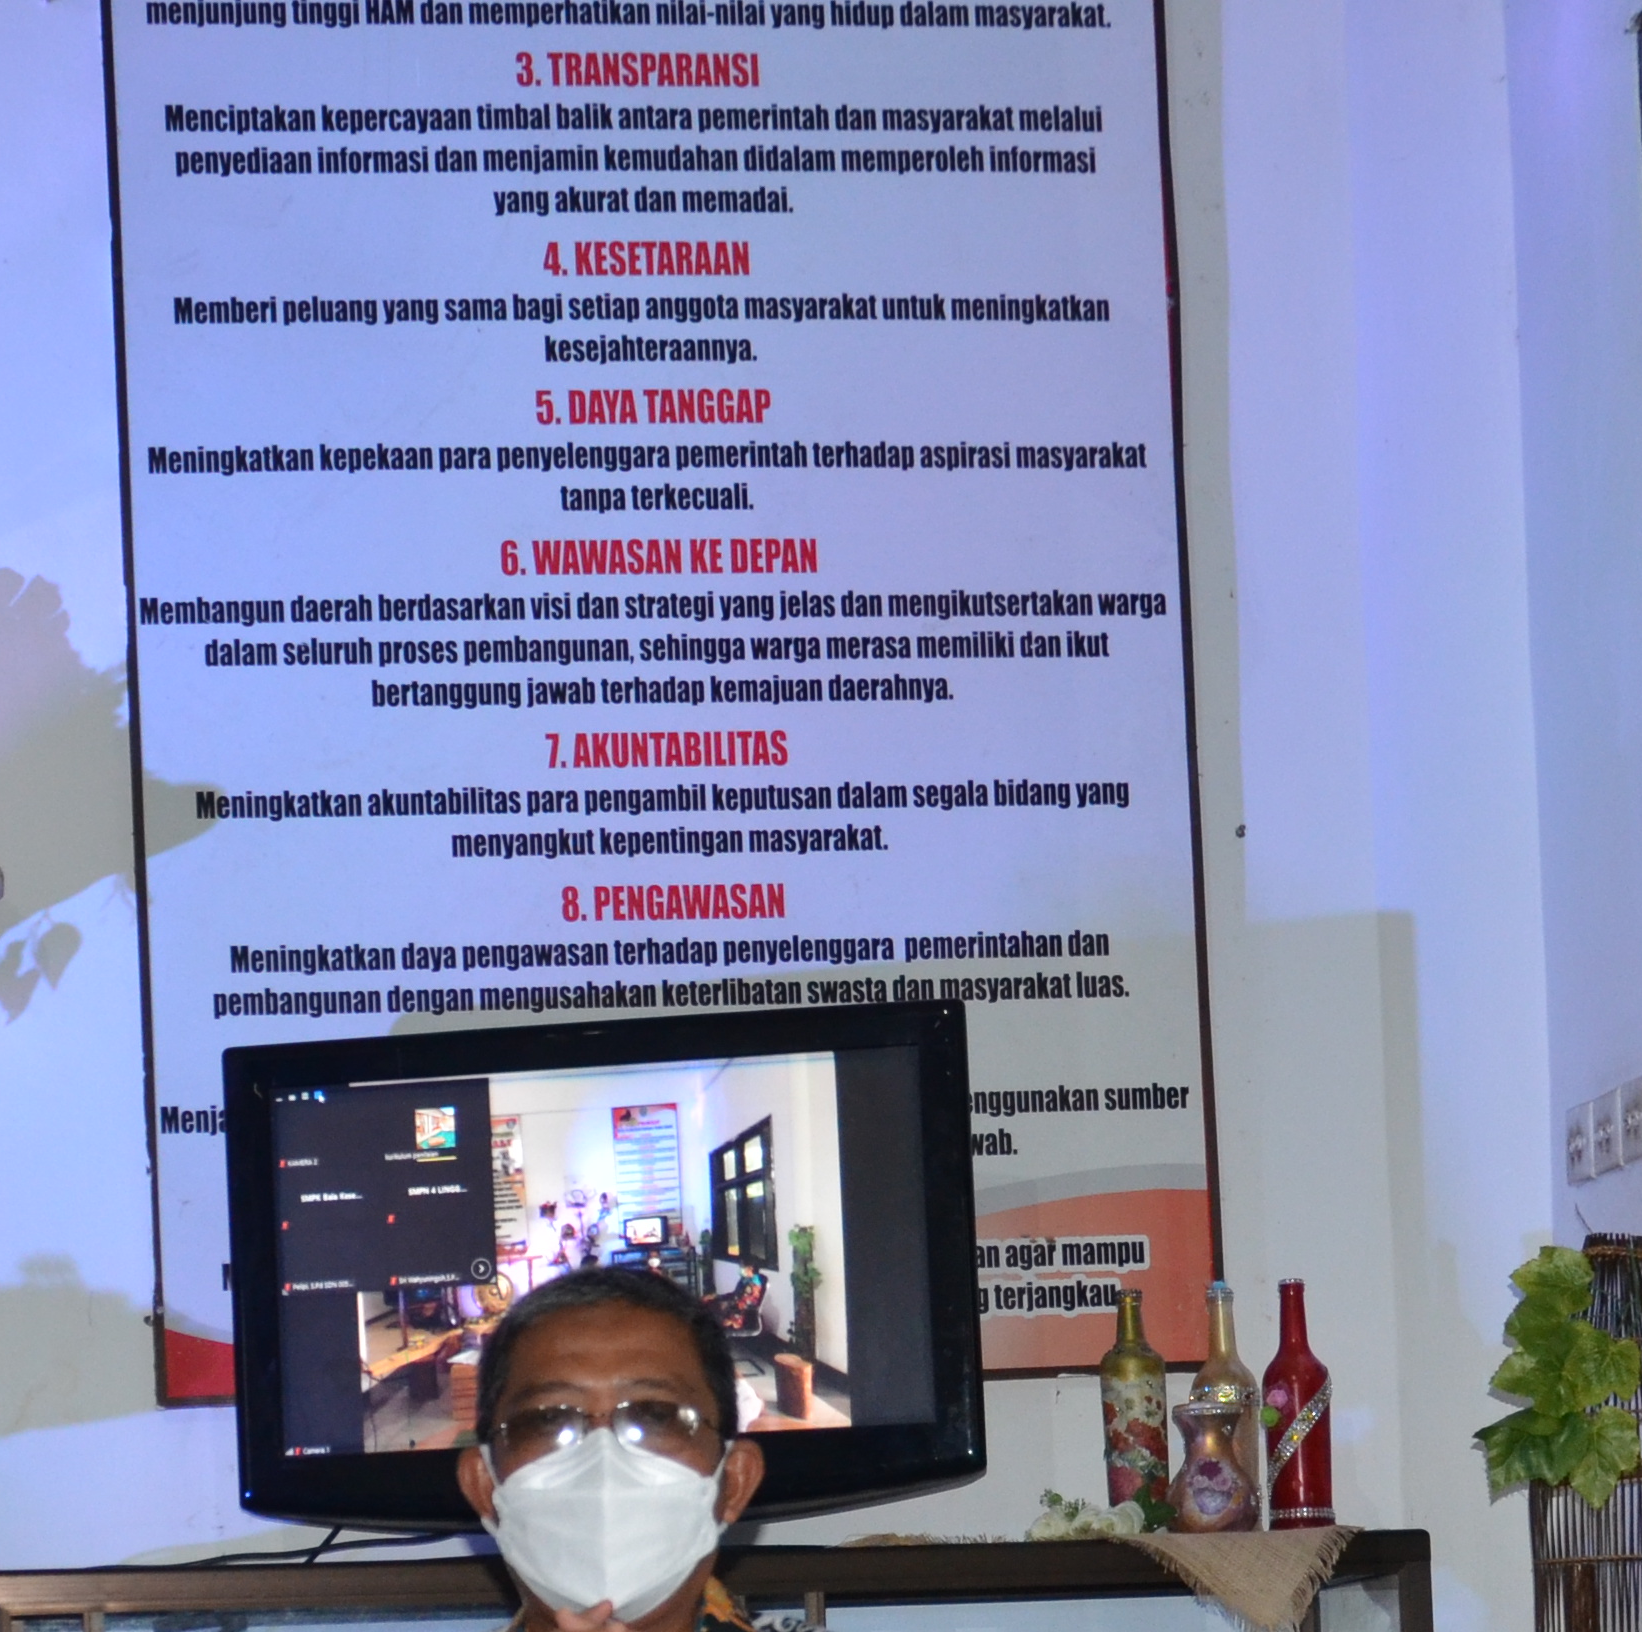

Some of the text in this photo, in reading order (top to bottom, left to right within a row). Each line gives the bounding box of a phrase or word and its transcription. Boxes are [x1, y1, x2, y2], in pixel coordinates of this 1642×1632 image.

[146, 0, 1111, 30] menjunjung tinggi HAM dan memperhatikan nilai-nilai yang hidup dalam masyarakat.
[516, 52, 759, 87] 3. TRANSPARANSI
[165, 103, 1102, 135] Menciptakan kepercayaan timbal balik antara pemerintah dan masyarakat melalui
[175, 145, 1096, 177] penyediaan informasi dan menjamin kemudahan didalam memperoleh informasi
[493, 186, 793, 216] yang akurat dan memadai.
[543, 241, 749, 276] 4. KESETARAAN
[174, 293, 1109, 326] Memberi peluang yang sama bagi setiap anggota masyarakat untuk meningkatkan
[545, 335, 757, 365] kesejahteraannya.
[536, 389, 771, 425] 5. DAYA TANGGAP
[148, 441, 1147, 476] Meningkatkan kepekaan para penyelenggara pemerintah terhadap aspirasi masyarakat
[560, 483, 753, 514] tanpa terkecuali.
[501, 539, 817, 576] 6. WAWASAN KE DEPAN
[140, 589, 1166, 627] Membangun daerah berdasarkan visi dan strategi yang jelas dan mengikutsertakan warga
[205, 631, 1109, 667] dalam seluruh proses pembangunan, sehingga warga merasa memiliki dan ikut
[372, 674, 953, 709] bertanggung jawab terhadap kemajuan daerahnya.
[545, 730, 788, 768] 7. AKUNTABILITAS
[196, 779, 1129, 821] Meningkatkan akuntabilitas para pengambil keputusan dalam segala bidang yang
[452, 824, 888, 859] menyangkut kepentingan masyarakat.
[562, 883, 785, 922] 8. PENGAWASAN
[230, 930, 1109, 975] Meningkatkan daya pengawasan terhadap penyelenggara pemerintahan dan
[213, 971, 1131, 1019] pembangunan dengan mengusahakan keterlibatan swasta dan masyarakat luas.
[1104, 1083, 1189, 1111] sumber
[1005, 1243, 1056, 1271] agar
[1062, 1241, 1145, 1268] mampu
